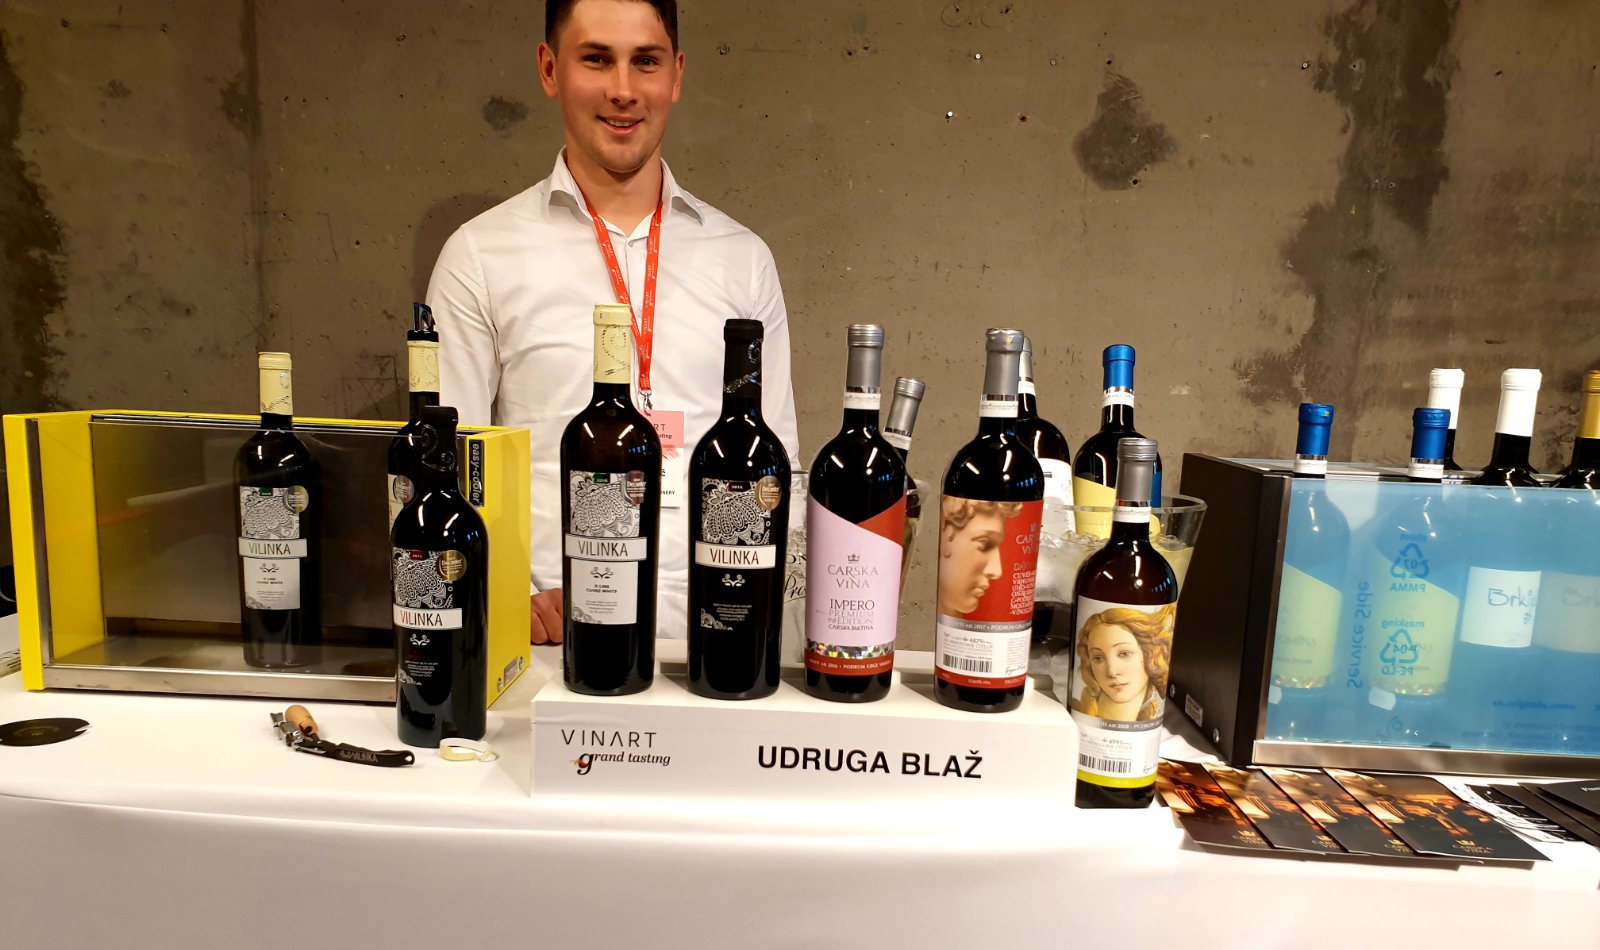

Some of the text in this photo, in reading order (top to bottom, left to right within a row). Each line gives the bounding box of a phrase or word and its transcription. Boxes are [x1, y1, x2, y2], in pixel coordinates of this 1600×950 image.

[471, 443, 482, 504] easy-cooler
[249, 541, 291, 555] VILINKA
[577, 540, 629, 557] VILINKA
[709, 548, 760, 565] VILINKA
[827, 564, 878, 578] CARSKA
[830, 598, 875, 611] IMPERO
[401, 612, 443, 627] VILINKA
[561, 729, 657, 748] VINART
[577, 751, 671, 775] grand tasting
[758, 745, 983, 779] UDRUGA BLAŽ
